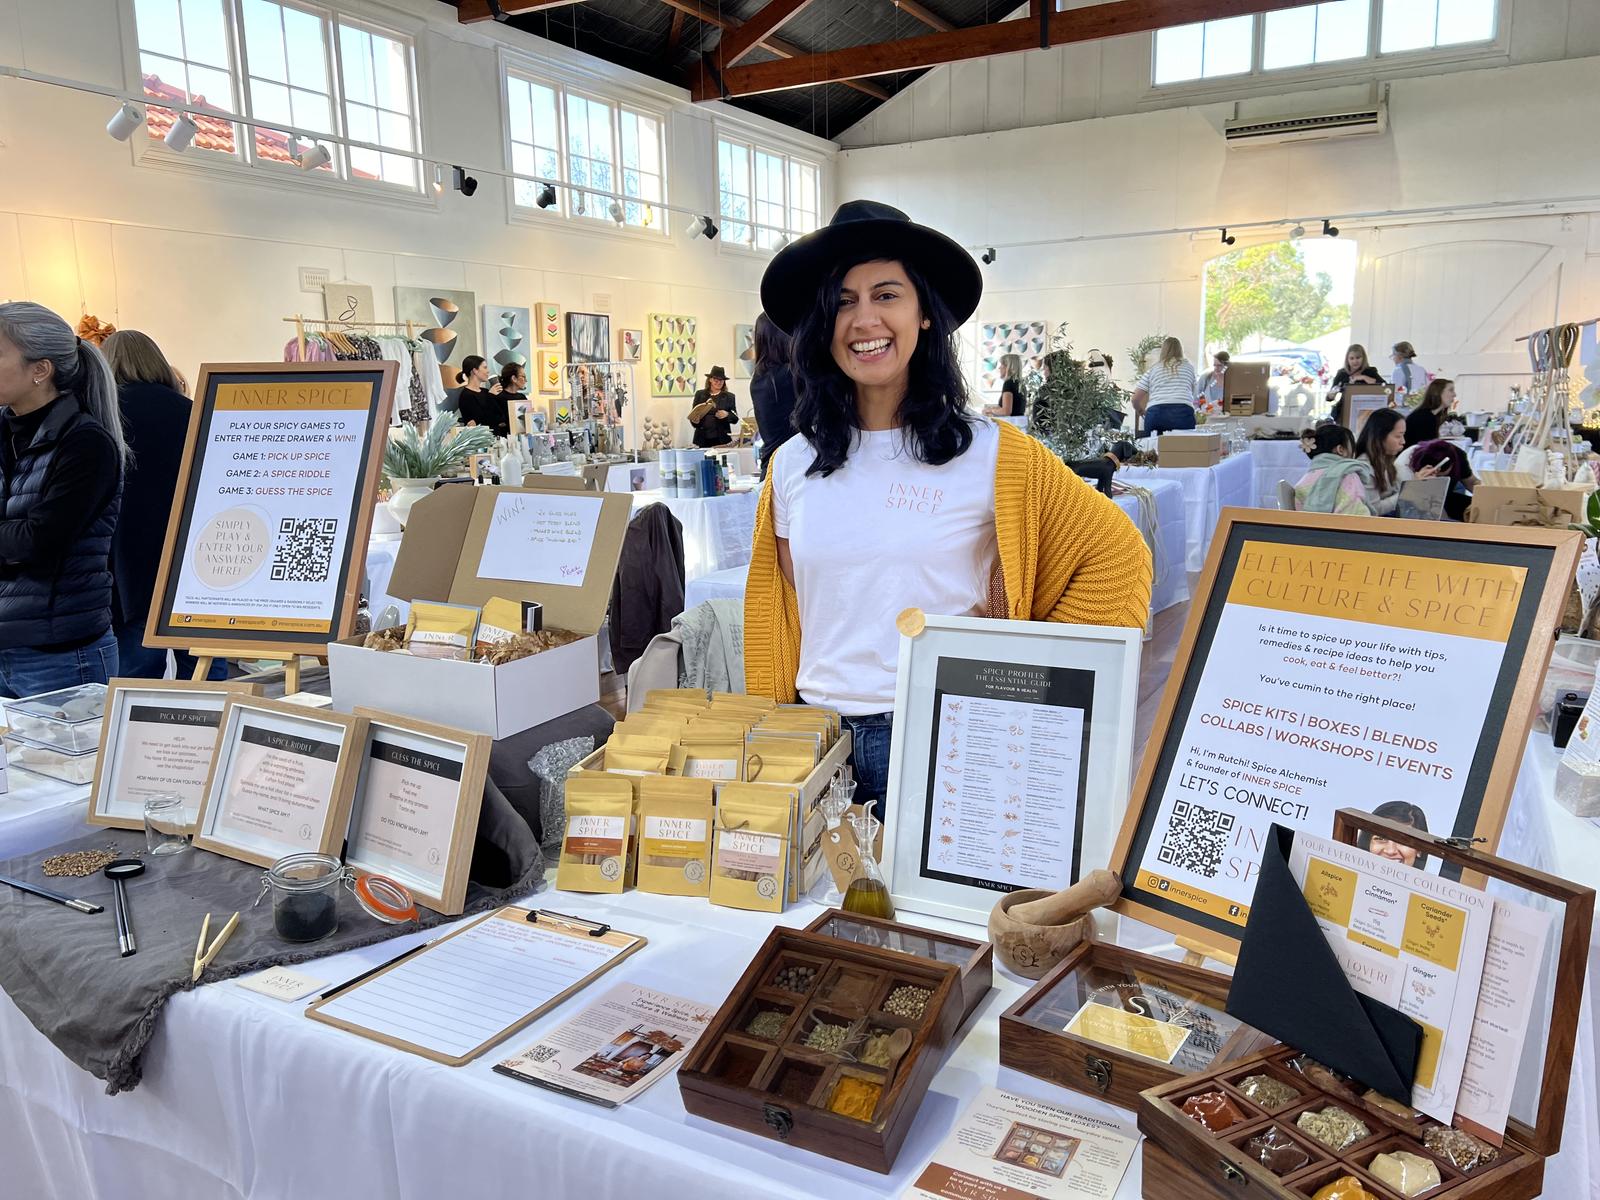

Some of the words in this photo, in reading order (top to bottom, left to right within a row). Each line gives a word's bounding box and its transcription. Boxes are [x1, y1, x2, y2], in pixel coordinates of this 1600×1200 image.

[233, 390, 288, 404] INNER
[297, 389, 352, 405] SPICE
[890, 482, 944, 503] INNER
[496, 496, 525, 525] WIN!
[886, 497, 940, 514] SPICE
[216, 521, 251, 529] SIMPLY
[199, 543, 231, 553] ENTER
[236, 544, 263, 553] YOUR
[205, 555, 253, 564] ANSWERS
[212, 566, 241, 575] HERE!
[1242, 553, 1352, 583] ELEVATE
[1363, 566, 1421, 590] LIFE
[1435, 574, 1519, 602] WITH
[1247, 578, 1365, 611] CULTURE
[1377, 595, 1393, 614] &
[1405, 599, 1495, 628] SPICE
[1277, 626, 1298, 636] time
[1312, 632, 1337, 644] spice
[1339, 638, 1352, 646] up
[1355, 640, 1378, 650] your
[1380, 642, 1396, 652] life
[1398, 646, 1421, 656] with
[1424, 650, 1447, 662] tips,
[1260, 638, 1302, 651] remedies
[1313, 646, 1344, 658] recipe
[1346, 651, 1373, 663] ideas
[1376, 656, 1386, 664] to
[1389, 658, 1412, 670] help
[1415, 664, 1435, 673] you
[1008, 670, 1045, 679] PROFILES
[1283, 655, 1308, 666] cook,
[1310, 659, 1327, 669] eat
[1339, 664, 1358, 674] feel
[1360, 668, 1401, 681] better?!
[991, 676, 1027, 685] ESSENTIAL
[1260, 674, 1290, 686] You've
[1292, 681, 1322, 692] cumin
[1324, 686, 1334, 695] to
[1337, 690, 1353, 699] the
[1355, 693, 1380, 705] right
[1382, 698, 1416, 711] place!
[1222, 698, 1263, 715] SPICE
[1265, 707, 1297, 723] KITS
[1308, 716, 1360, 736] BOXES
[1371, 729, 1438, 753] BLENDS
[1200, 714, 1264, 736] COLLABS
[1275, 730, 1374, 762] WORKSHOPS
[1385, 755, 1453, 780] EVENTS
[391, 751, 409, 762] GUESS
[411, 757, 422, 766] THE
[423, 761, 440, 771] SPICE
[1190, 746, 1200, 755] Hi,
[1203, 749, 1216, 759] I'm
[1218, 753, 1250, 767] Rutchi!
[1252, 761, 1277, 774] Spice
[1279, 769, 1327, 787] Alchemist
[1195, 760, 1229, 776] founder
[1242, 773, 1270, 786] INNER
[1273, 781, 1302, 795] SPICE
[1180, 773, 1219, 795] LET'S
[1224, 786, 1309, 820] CONNECT!
[578, 827, 608, 836] SPICE
[580, 818, 609, 826] INNER
[659, 819, 692, 830] INNER
[659, 829, 690, 838] SPICE
[734, 833, 766, 843] INNER
[1234, 826, 1265, 853] IN
[733, 841, 763, 853] SPICE
[1301, 840, 1325, 851] YOUR
[1328, 847, 1377, 870] EVERYDAY
[1380, 863, 1410, 881] SPICE
[1414, 877, 1486, 909] COLLECTION
[1321, 870, 1342, 882] Allspice
[1170, 884, 1208, 904] innerspice
[1372, 885, 1393, 897] Ceylon
[1420, 903, 1453, 918] Coriander
[1016, 1104, 1048, 1116] WOODEN
[1049, 1113, 1069, 1122] SPICE
[1071, 1119, 1101, 1129] BOXES?
[1038, 1104, 1055, 1112] SEEN
[1073, 1114, 1121, 1130] TRADITIONAL
